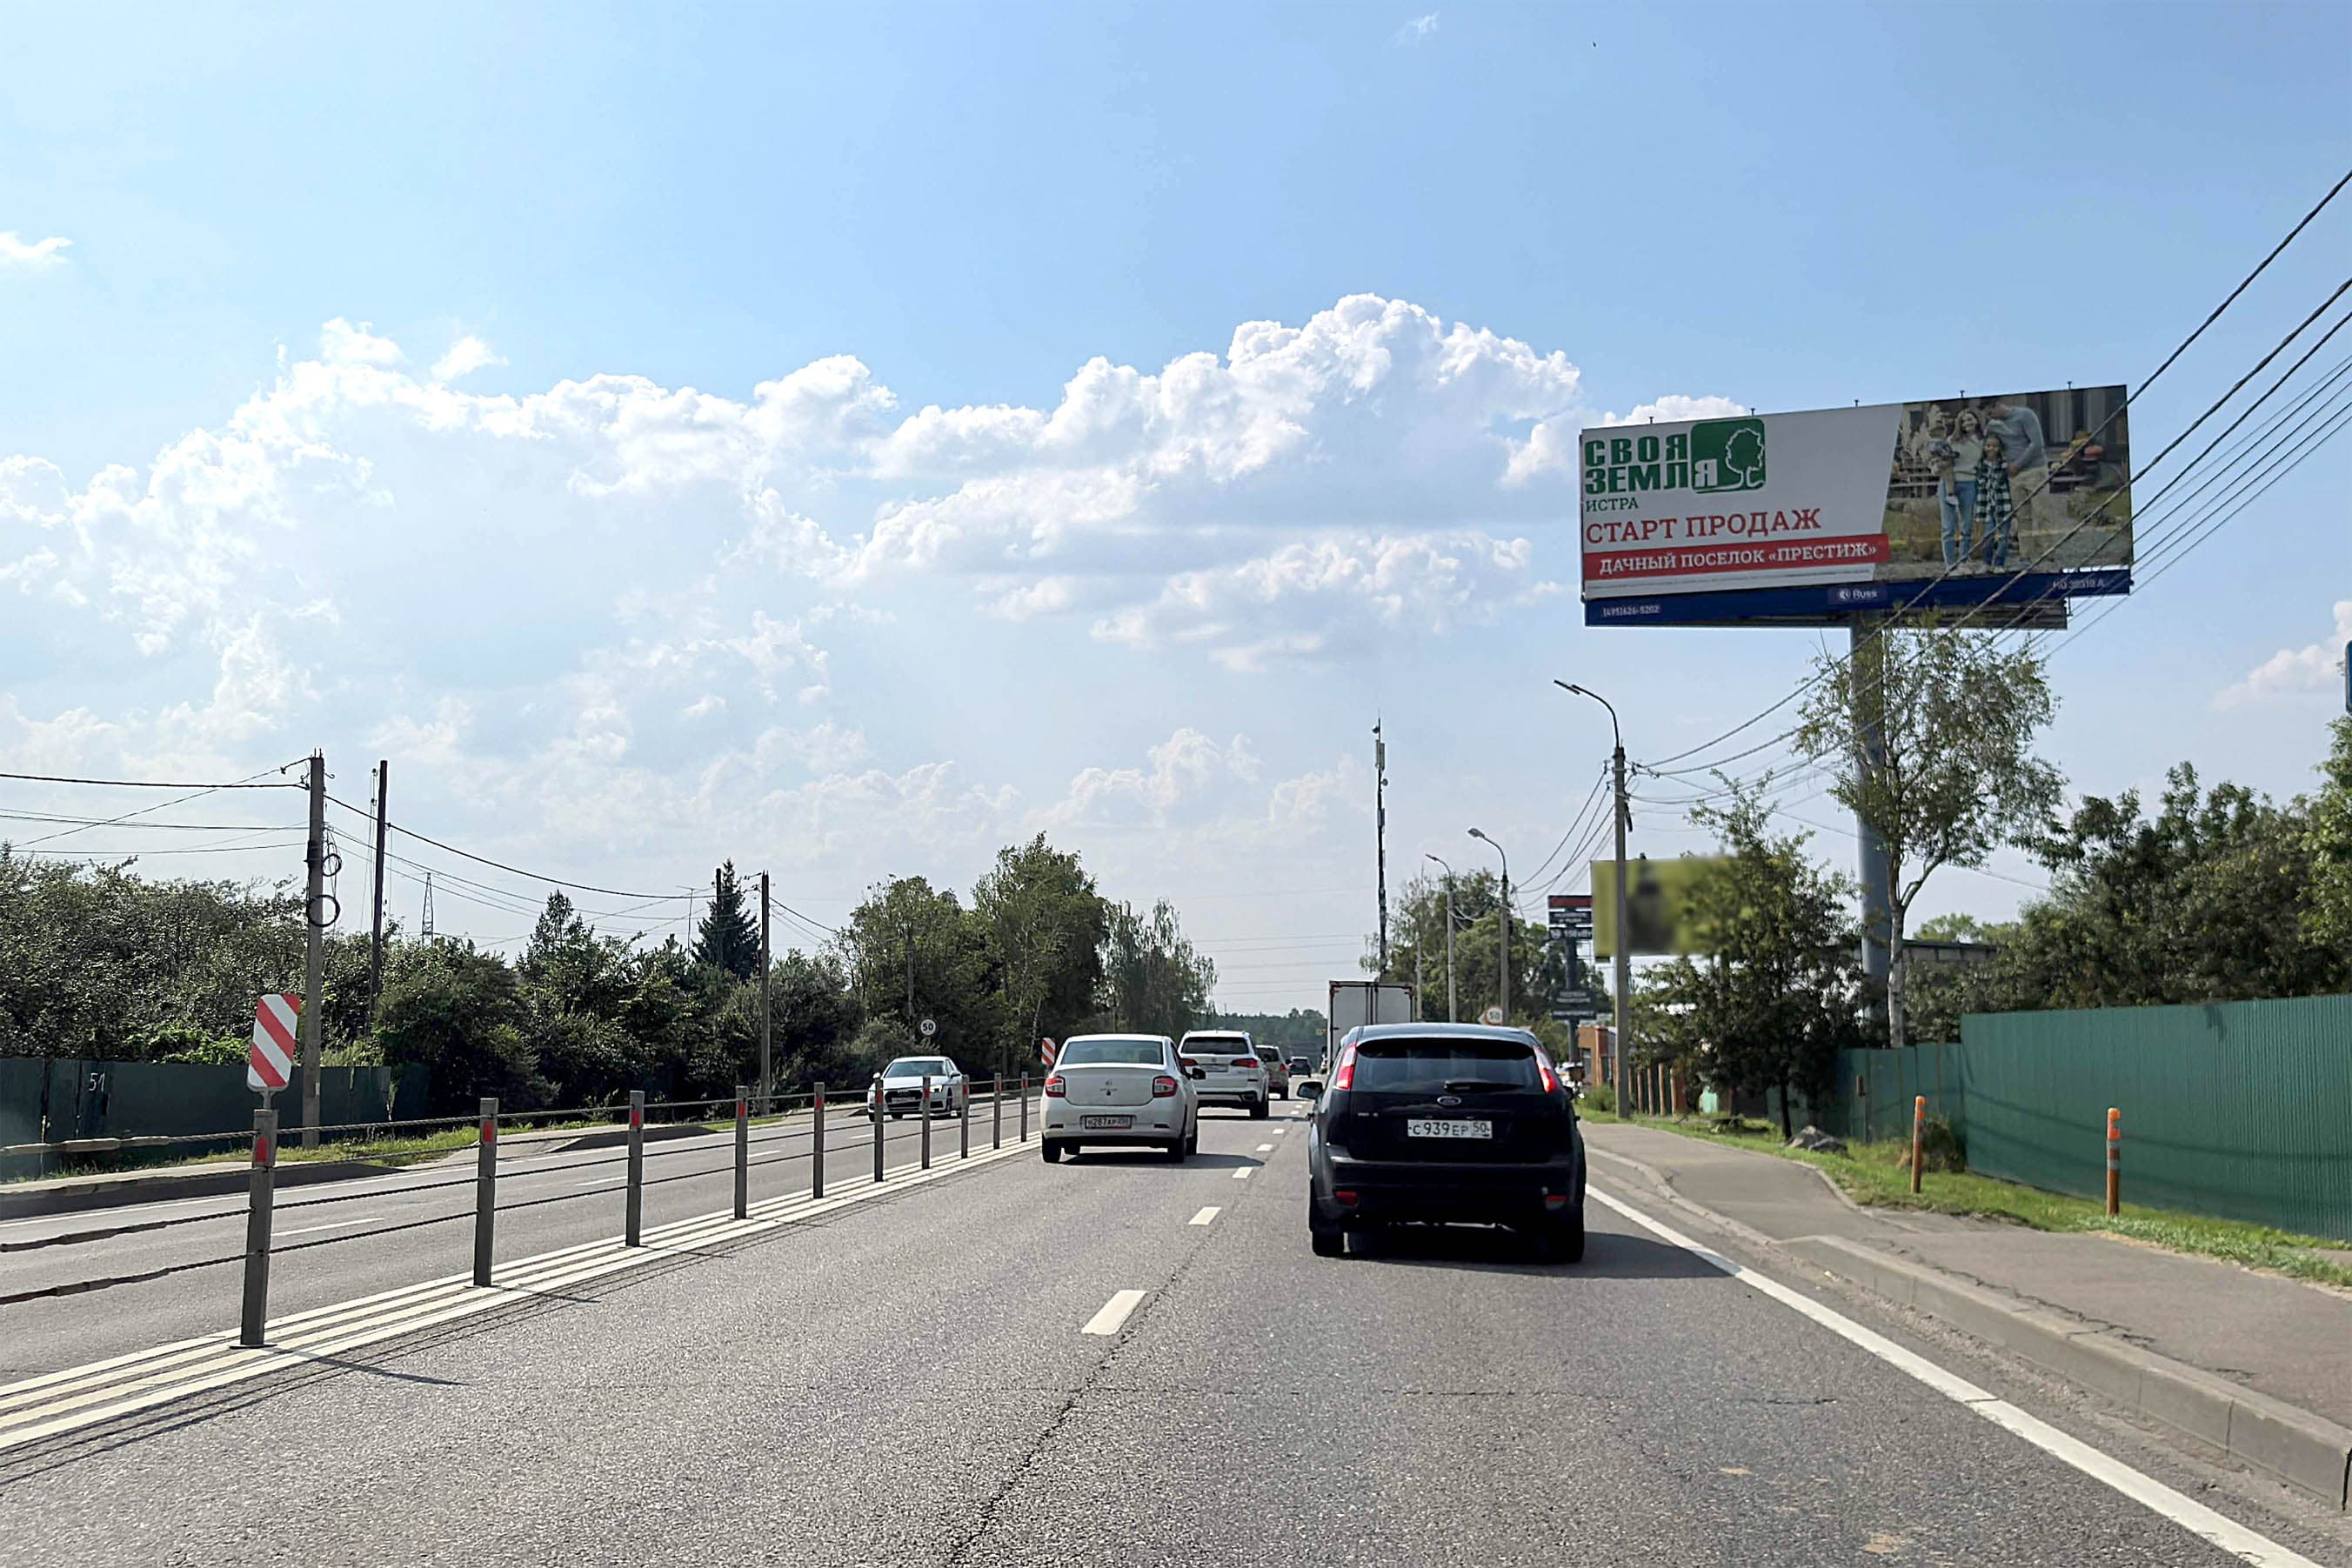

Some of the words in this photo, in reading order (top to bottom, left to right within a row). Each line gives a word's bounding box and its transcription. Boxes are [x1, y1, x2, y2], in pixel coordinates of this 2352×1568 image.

[1585, 434, 1687, 467] СВОЯ
[1585, 458, 1718, 494] ЗЕМЛЯ
[1586, 497, 1639, 511] ИСТРА
[1586, 518, 1677, 544] СТАРТ
[1686, 508, 1821, 537] ПРОДАЖ
[1600, 553, 1678, 575] ДАЧНЫЙ
[1681, 550, 1765, 568] ПОСЕЛОК
[1768, 542, 1877, 562] «ПРЕСТИЖ»
[923, 1023, 934, 1031] 50
[89, 1072, 105, 1092] 51
